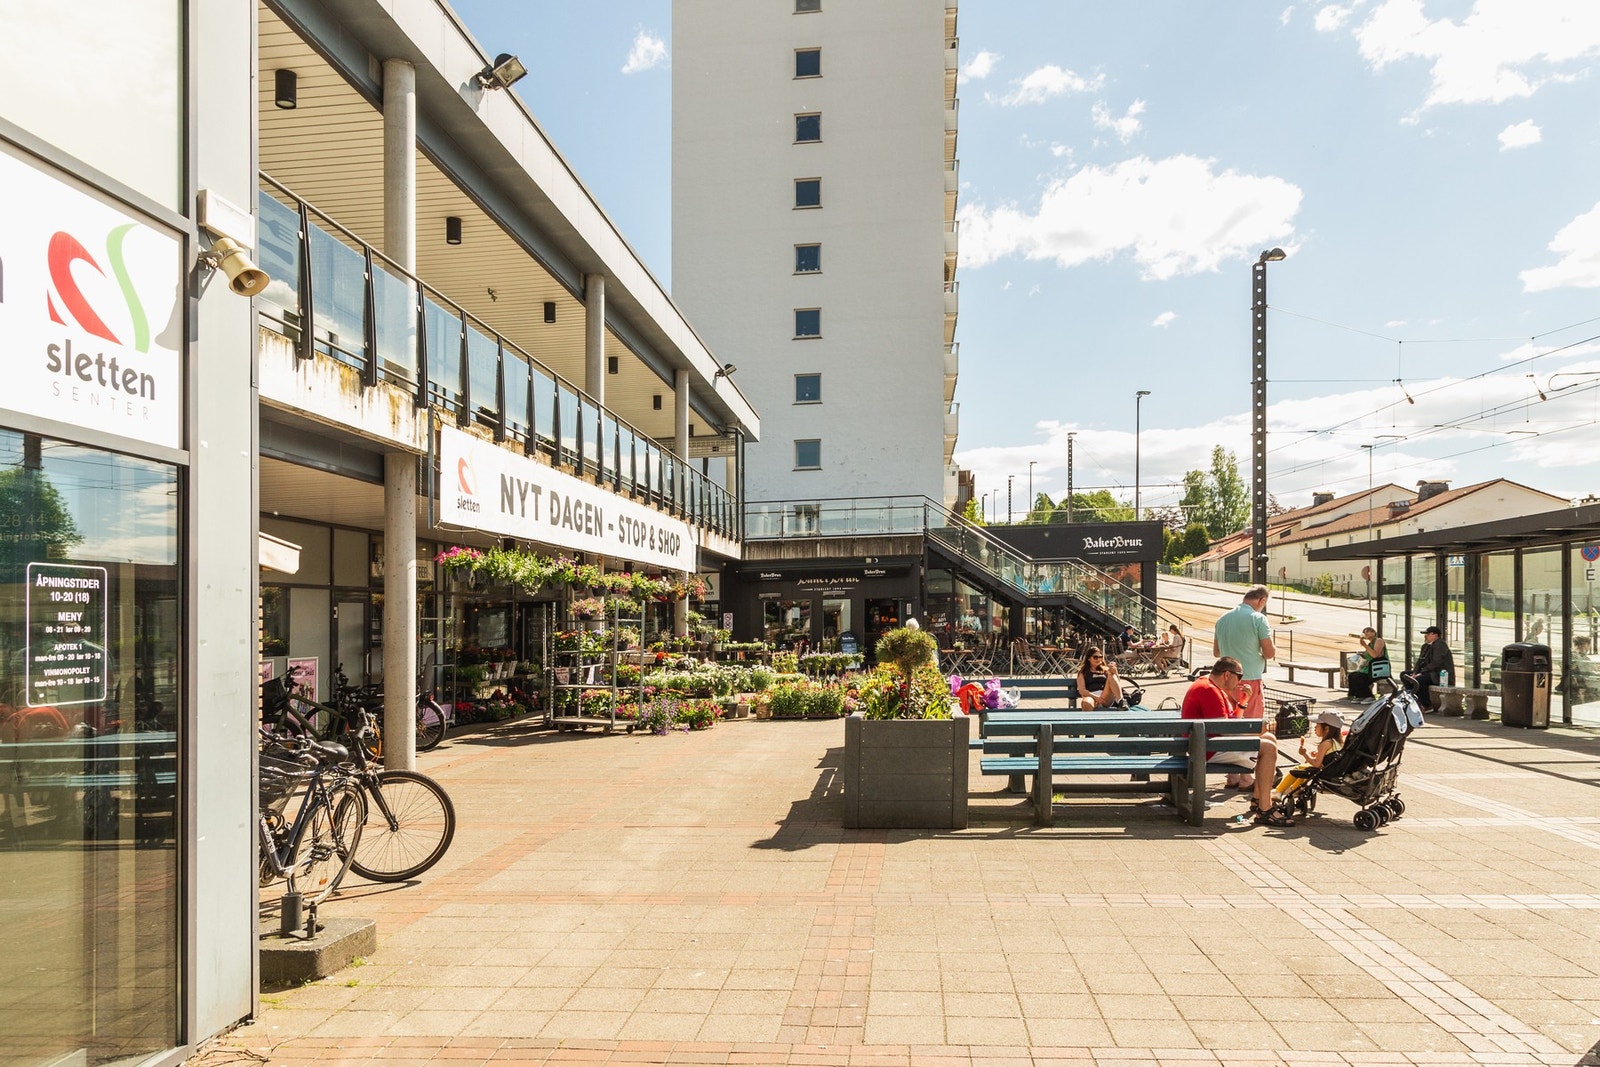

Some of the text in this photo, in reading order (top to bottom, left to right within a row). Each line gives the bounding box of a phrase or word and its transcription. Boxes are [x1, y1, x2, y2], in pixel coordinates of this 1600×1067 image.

[46, 339, 155, 401] sletten
[52, 381, 149, 420] SENTER
[457, 495, 481, 513] sletten
[500, 473, 542, 521] NYT
[550, 490, 603, 538] DAGEN
[618, 514, 647, 548] STOP
[649, 525, 655, 551] &
[658, 528, 681, 557] SHOP
[1082, 536, 1143, 550] BakerBrun
[36, 573, 100, 589] ÅPNINGSTIDER
[1586, 568, 1596, 581] E
[50, 591, 90, 604] 10-20 (18)
[57, 612, 83, 622] MENY
[43, 667, 91, 677] VINMONOPOLET
